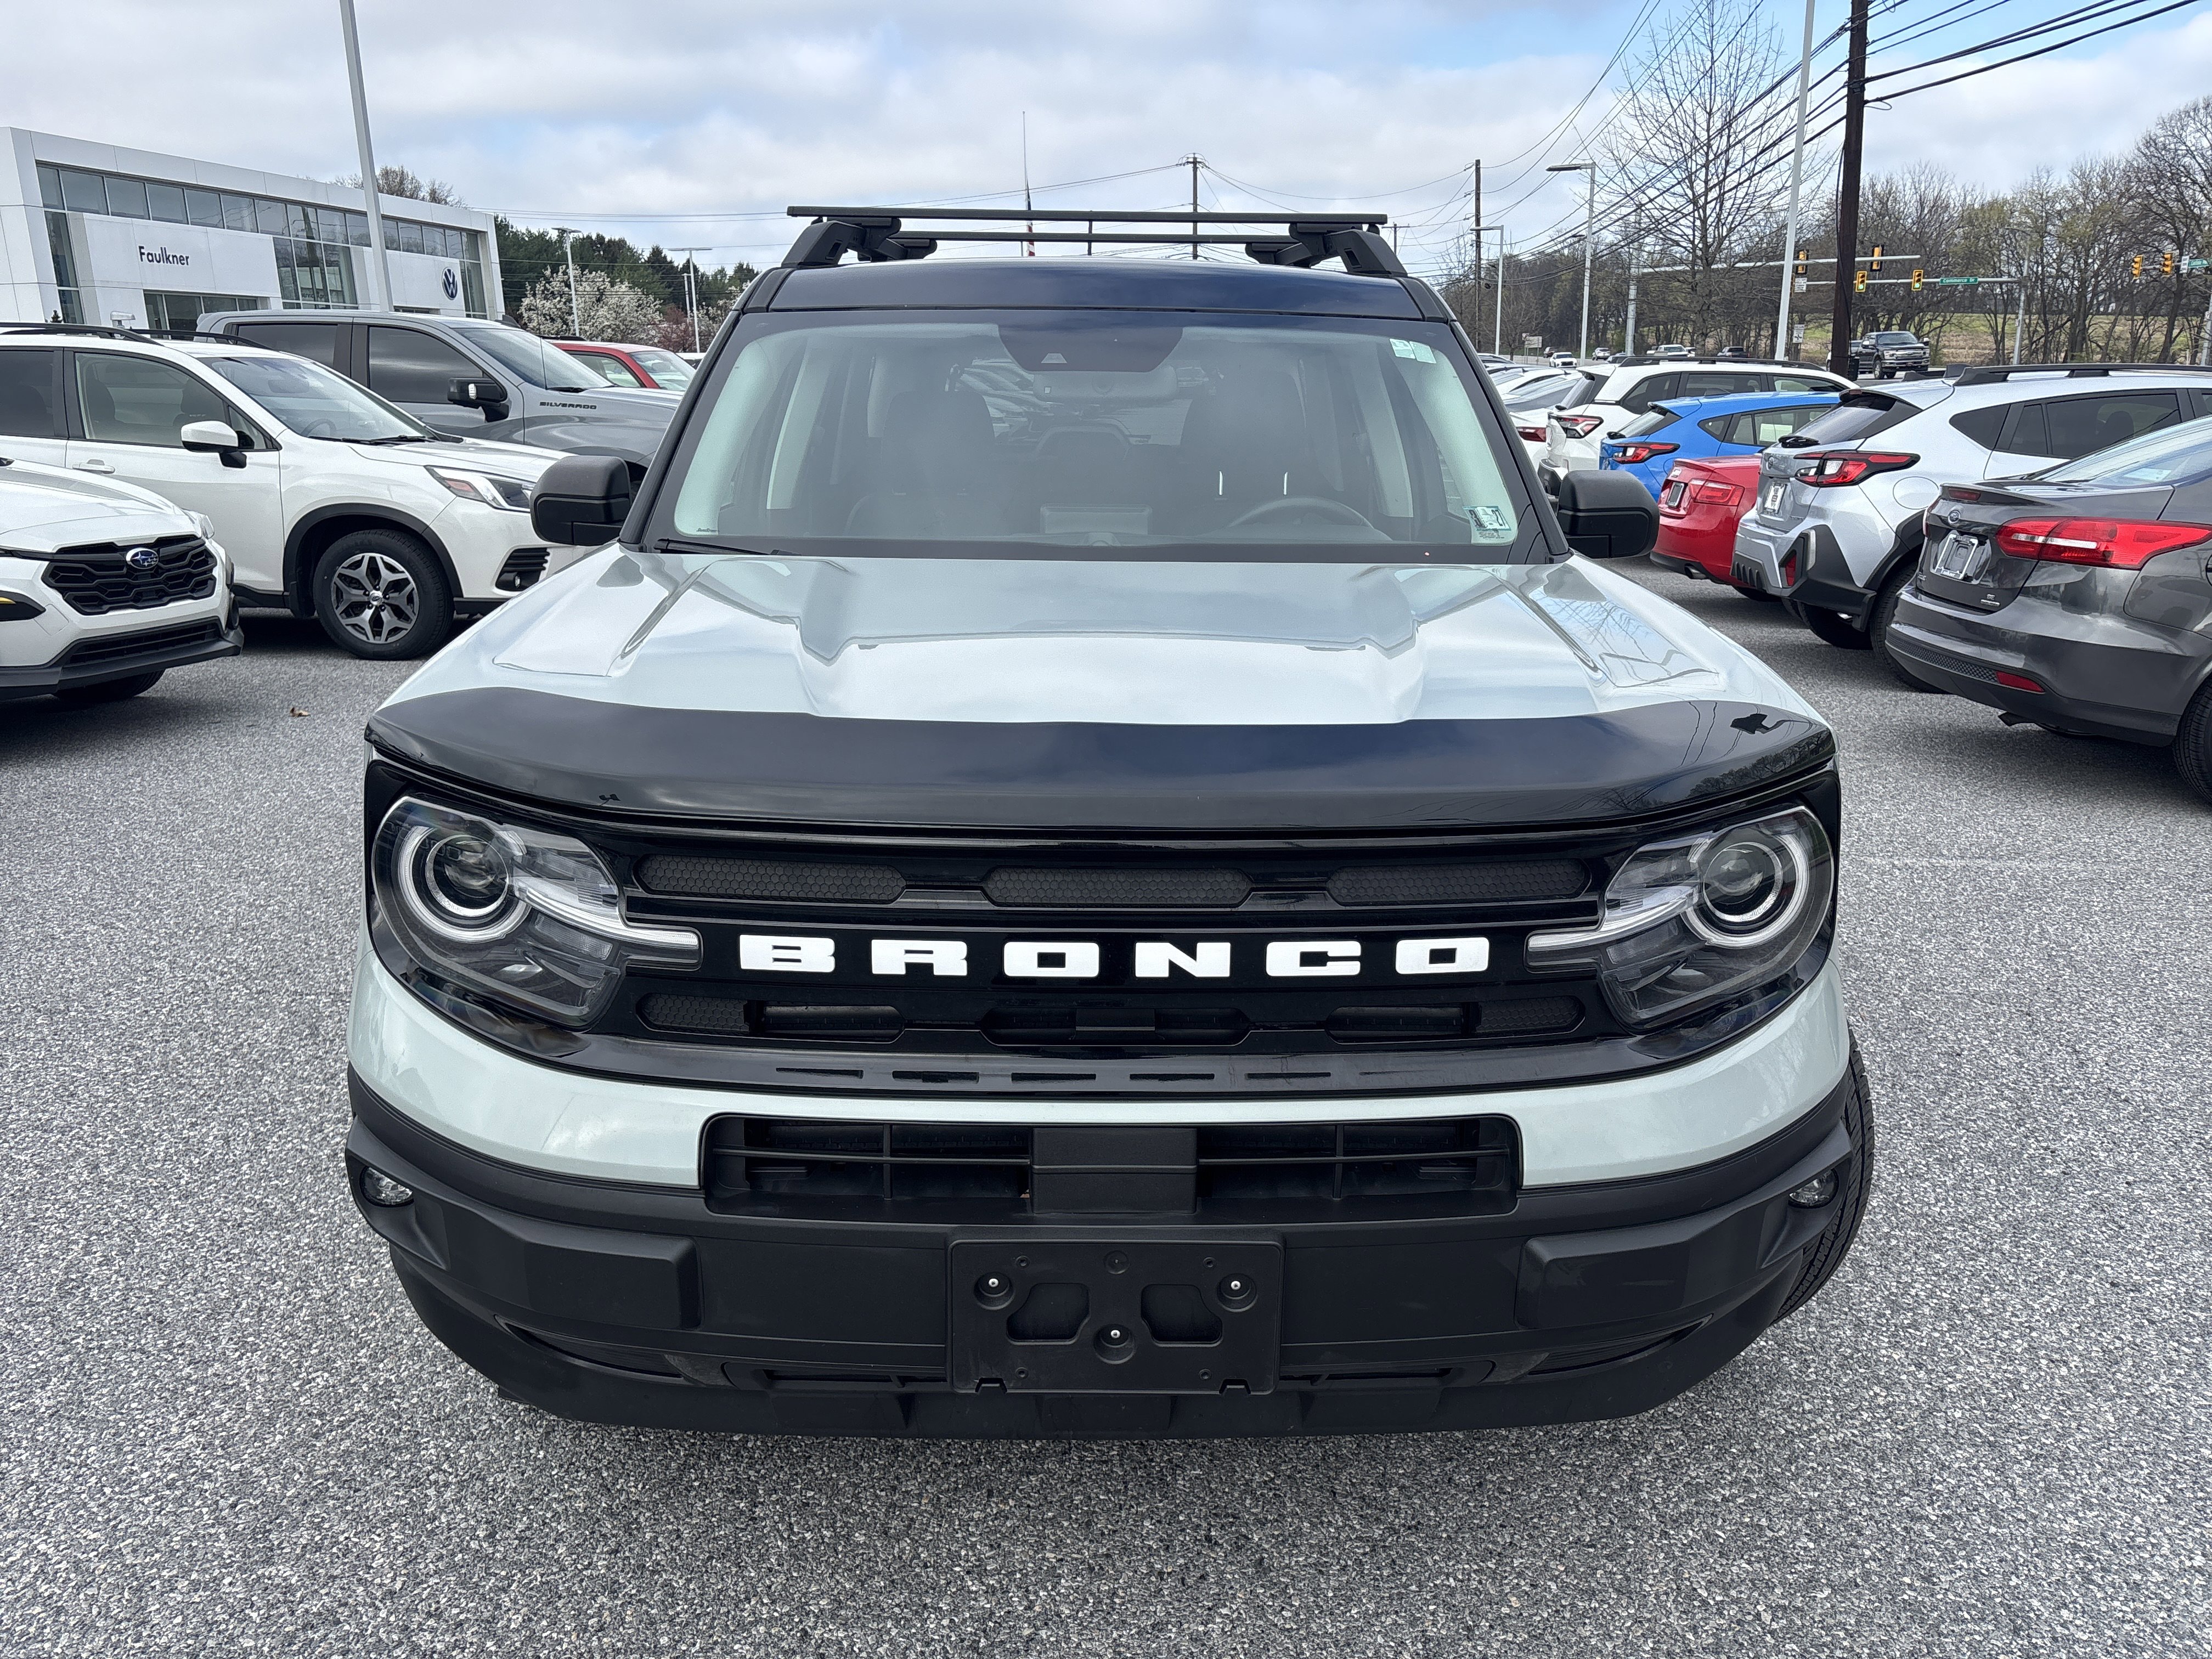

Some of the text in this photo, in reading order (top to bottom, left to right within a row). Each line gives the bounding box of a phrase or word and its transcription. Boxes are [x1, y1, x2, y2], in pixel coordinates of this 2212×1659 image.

[138, 245, 189, 266] Faulkner
[442, 268, 458, 298] VW
[539, 402, 597, 410] SILVERADO
[739, 933, 1490, 978] BRONCO
